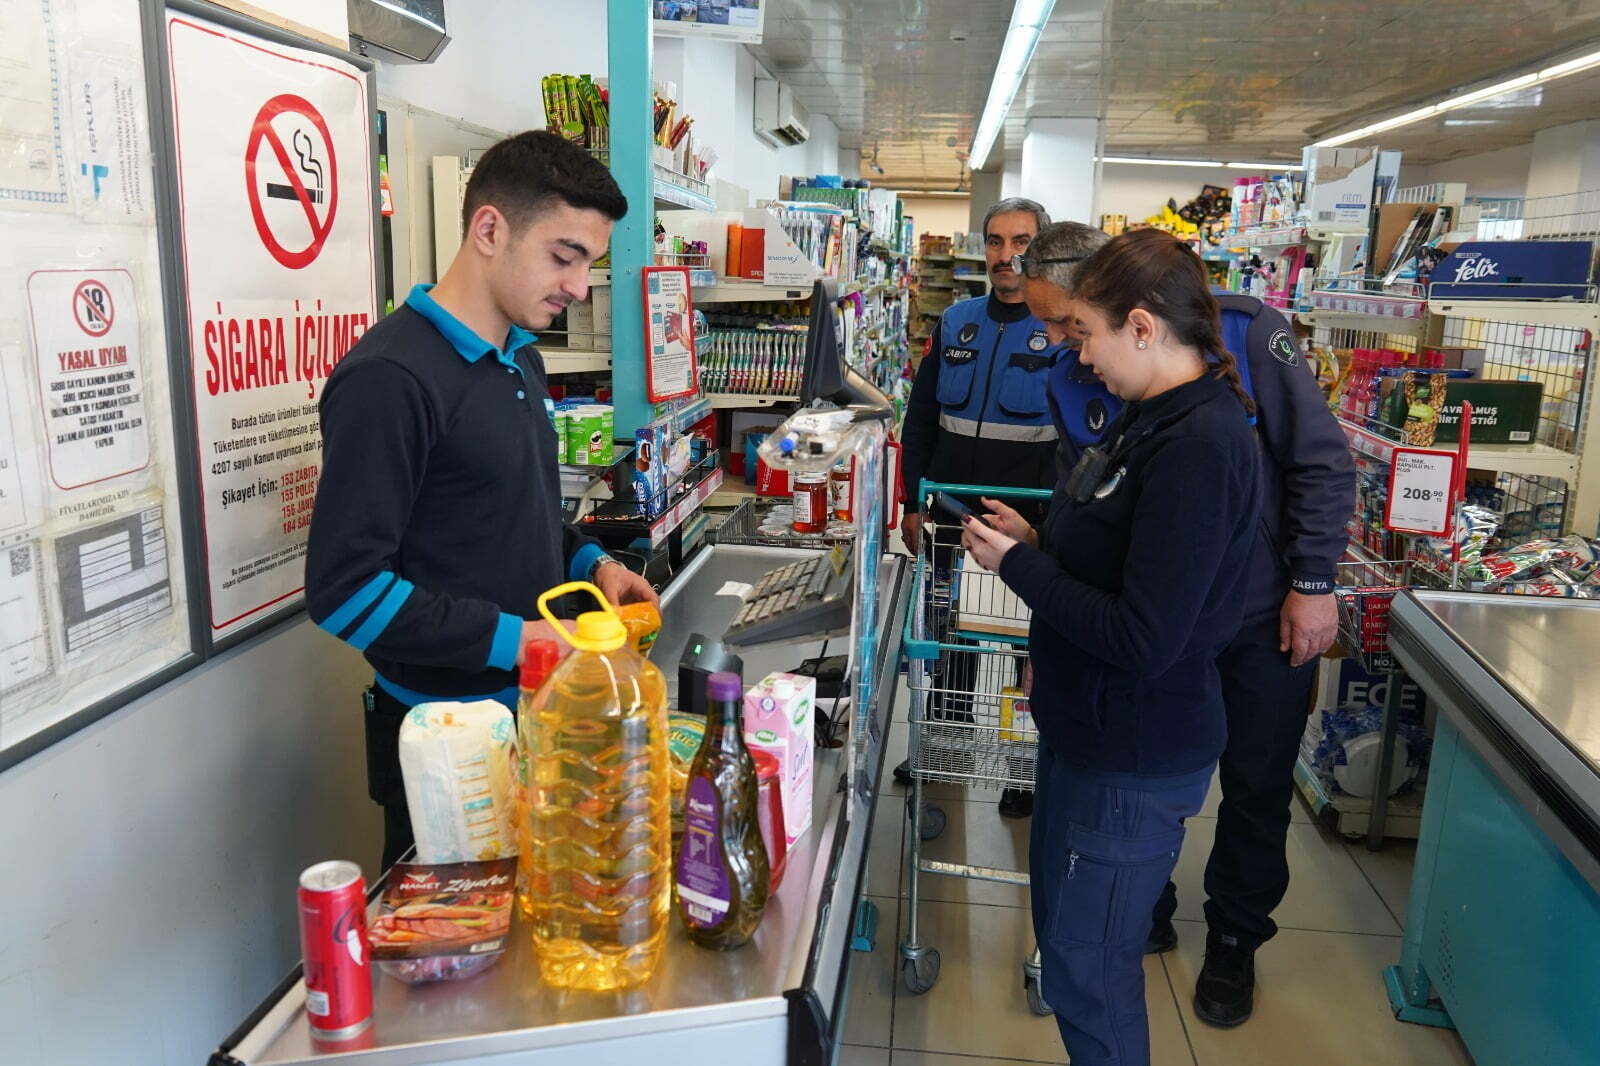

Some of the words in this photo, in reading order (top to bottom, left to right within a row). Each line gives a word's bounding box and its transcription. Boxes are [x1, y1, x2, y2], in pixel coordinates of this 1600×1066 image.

[1451, 257, 1499, 287] felix
[58, 350, 96, 370] YASAL
[99, 345, 127, 365] UYARI
[204, 301, 288, 396] SİGARA
[296, 299, 367, 399] İÇİLME
[232, 415, 257, 430] Burada
[259, 411, 275, 426] tütün
[277, 404, 300, 420] ürünleri
[1438, 414, 1459, 424] İİRT
[1470, 416, 1498, 425] STIĞI
[1441, 405, 1498, 416] AVRLMUŞ
[214, 436, 257, 454] Tüketenlere
[259, 436, 267, 445] ve
[268, 424, 308, 443] tüketilmesine
[310, 422, 319, 435] göz
[212, 460, 231, 475] 4207
[234, 456, 252, 471] sayılı
[254, 451, 275, 465] Kanun
[276, 445, 302, 461] uyarınca
[304, 441, 316, 453] idari
[281, 472, 294, 487] 153
[296, 465, 318, 482] ZABITA
[222, 483, 256, 509] Şikayet
[259, 477, 278, 498] İçin:
[281, 489, 294, 502] 155
[296, 481, 315, 498] POLİS
[281, 503, 295, 519] 156
[282, 519, 296, 535] 184
[1292, 579, 1328, 590] ZABITA
[400, 882, 441, 890] NAMET
